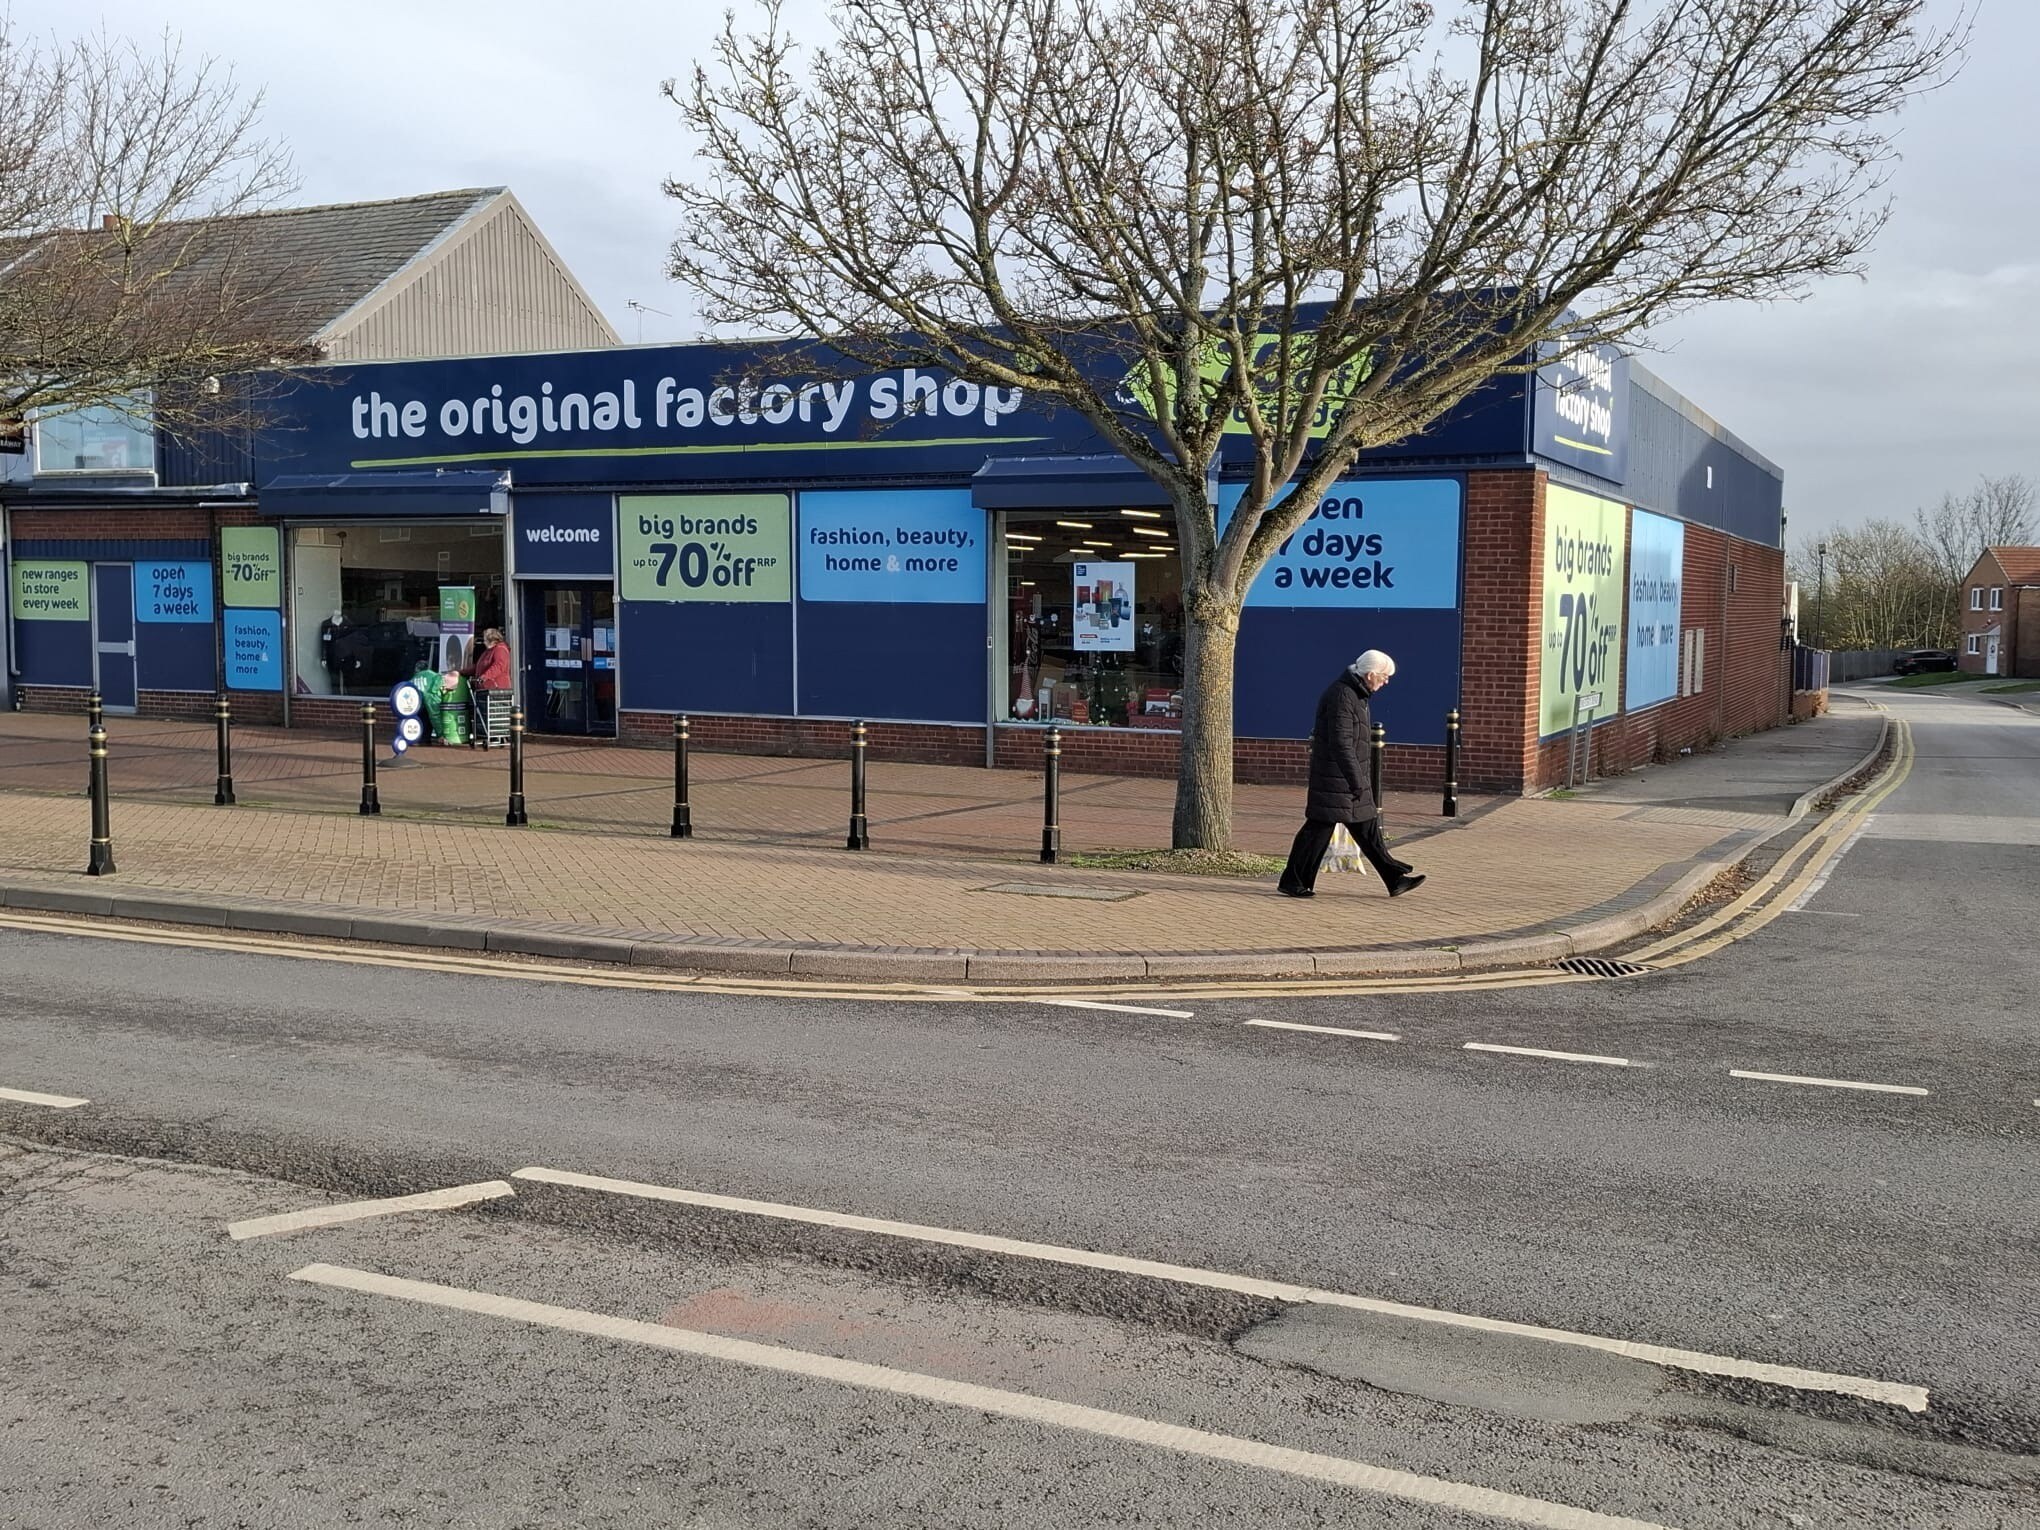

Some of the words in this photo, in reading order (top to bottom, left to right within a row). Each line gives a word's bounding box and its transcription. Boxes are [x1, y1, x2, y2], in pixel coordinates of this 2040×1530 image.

[352, 391, 427, 439] the
[440, 379, 642, 444] original
[656, 375, 855, 433] factory
[869, 367, 1024, 427] shop
[1556, 373, 1590, 435] factory
[1590, 395, 1611, 444] shop
[1303, 496, 1364, 526] en
[525, 524, 601, 543] welcome
[638, 514, 674, 540] big
[680, 514, 758, 538] brands
[810, 526, 891, 547] fashion,
[895, 528, 975, 548] beauty,
[1302, 527, 1383, 562] days
[227, 552, 241, 563] big
[242, 552, 270, 562] brands
[825, 554, 881, 572] home
[886, 554, 900, 573] &
[905, 556, 959, 572] more
[1555, 525, 1575, 584] big
[1577, 528, 1613, 577] brands
[22, 569, 44, 580] new
[44, 569, 79, 582] ranges
[152, 567, 185, 583] open
[253, 569, 269, 581] off
[633, 558, 647, 569] up
[647, 557, 658, 567] to
[712, 557, 756, 587] off
[757, 557, 777, 567] RRP
[1274, 568, 1293, 589] a
[1300, 559, 1396, 589] week
[22, 582, 33, 594] in
[34, 583, 60, 595] store
[152, 585, 161, 598] 7
[163, 584, 194, 601] days
[1633, 572, 1659, 607] fashion,
[22, 598, 49, 611] every
[50, 597, 79, 610] week
[153, 602, 161, 615] a
[164, 600, 199, 615] week
[234, 625, 271, 637] fashion,
[1636, 620, 1654, 649] home
[1660, 622, 1674, 646] more
[234, 639, 269, 651] beauty,
[235, 651, 261, 661] home
[1548, 631, 1557, 653] up
[1556, 628, 1563, 649] to
[1588, 624, 1609, 687] off
[235, 664, 259, 675] more
